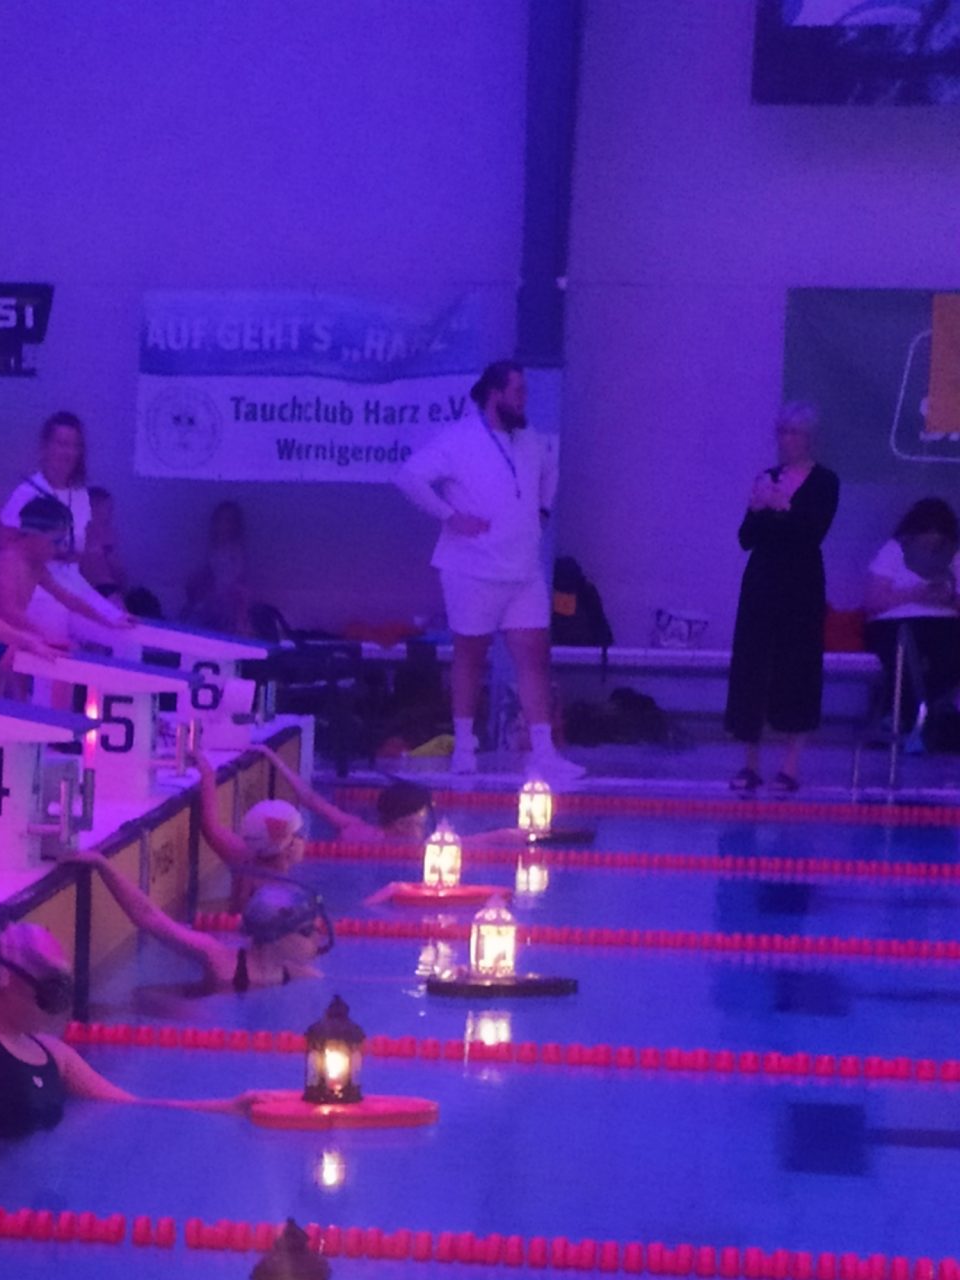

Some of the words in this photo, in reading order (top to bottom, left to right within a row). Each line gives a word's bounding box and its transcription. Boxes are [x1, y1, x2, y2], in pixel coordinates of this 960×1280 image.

[147, 317, 206, 350] AUF
[230, 395, 354, 426] Tauchclub
[364, 399, 420, 425] Harz
[191, 661, 222, 710] 6
[100, 694, 135, 753] 5
